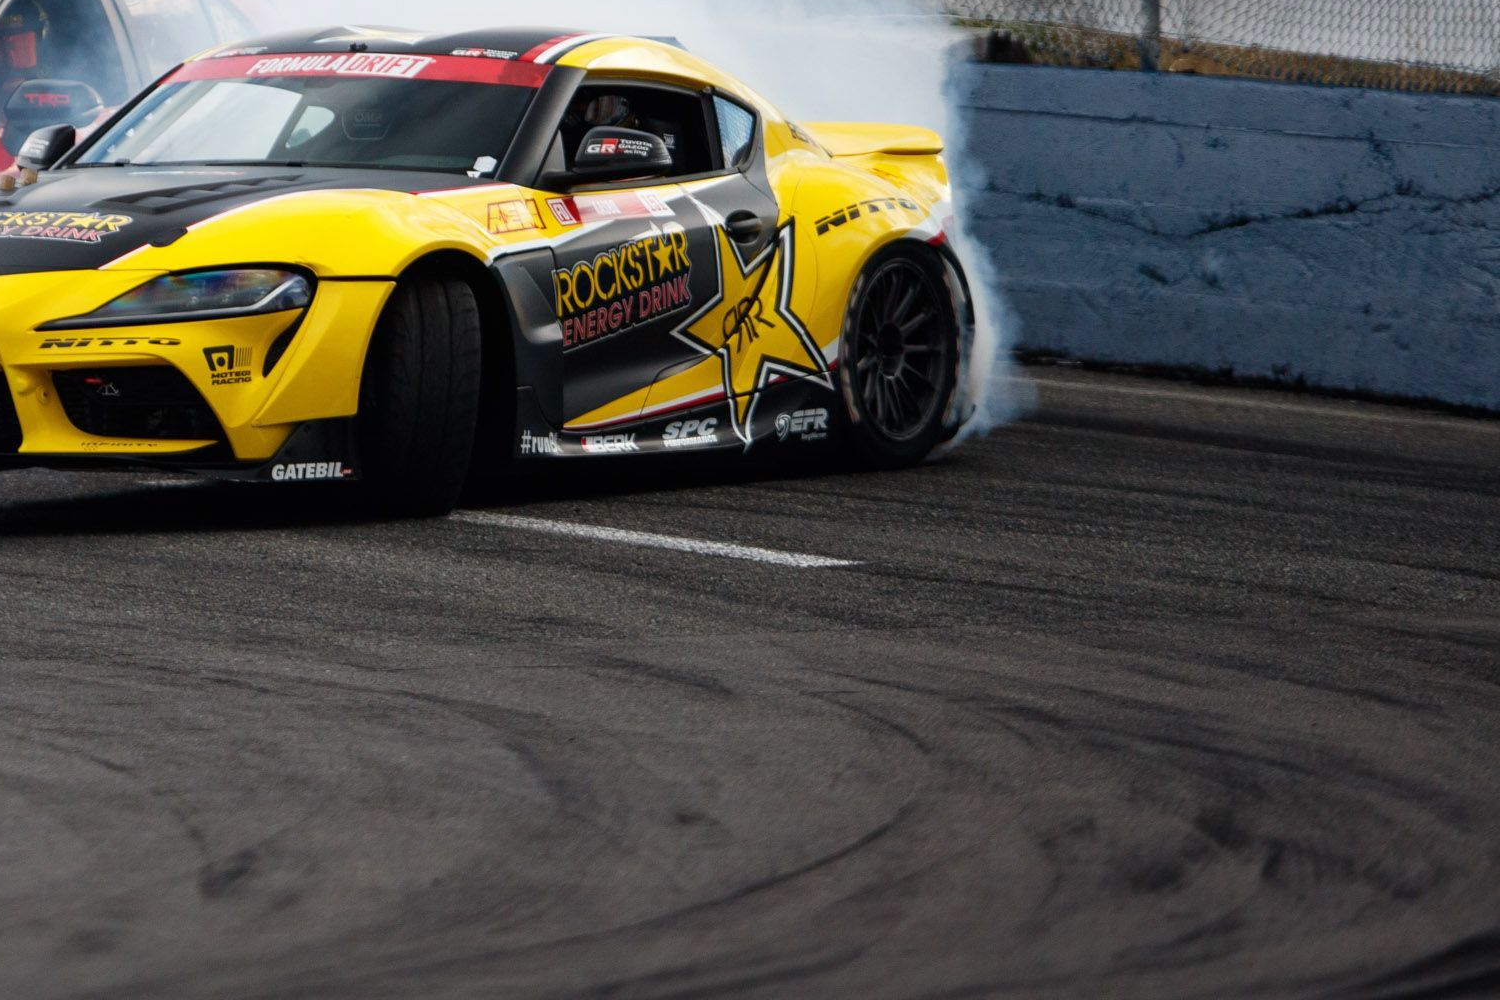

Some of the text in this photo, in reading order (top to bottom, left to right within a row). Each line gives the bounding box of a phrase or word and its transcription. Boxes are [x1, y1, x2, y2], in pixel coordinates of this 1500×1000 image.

[586, 143, 616, 154] GR
[620, 138, 653, 148] TOYOTA
[814, 197, 918, 237] NITTO
[21, 225, 105, 242] DRINK
[562, 273, 691, 348] ENERGY DRINK
[39, 337, 182, 349] NITTO
[211, 370, 252, 379] MOTEGI
[211, 376, 252, 386] RACING
[662, 417, 719, 439] SPC
[790, 407, 828, 432] EFR
[593, 433, 640, 453] BERK
[663, 434, 719, 448] PERFORMANCE
[271, 461, 344, 481] GATEBIL
